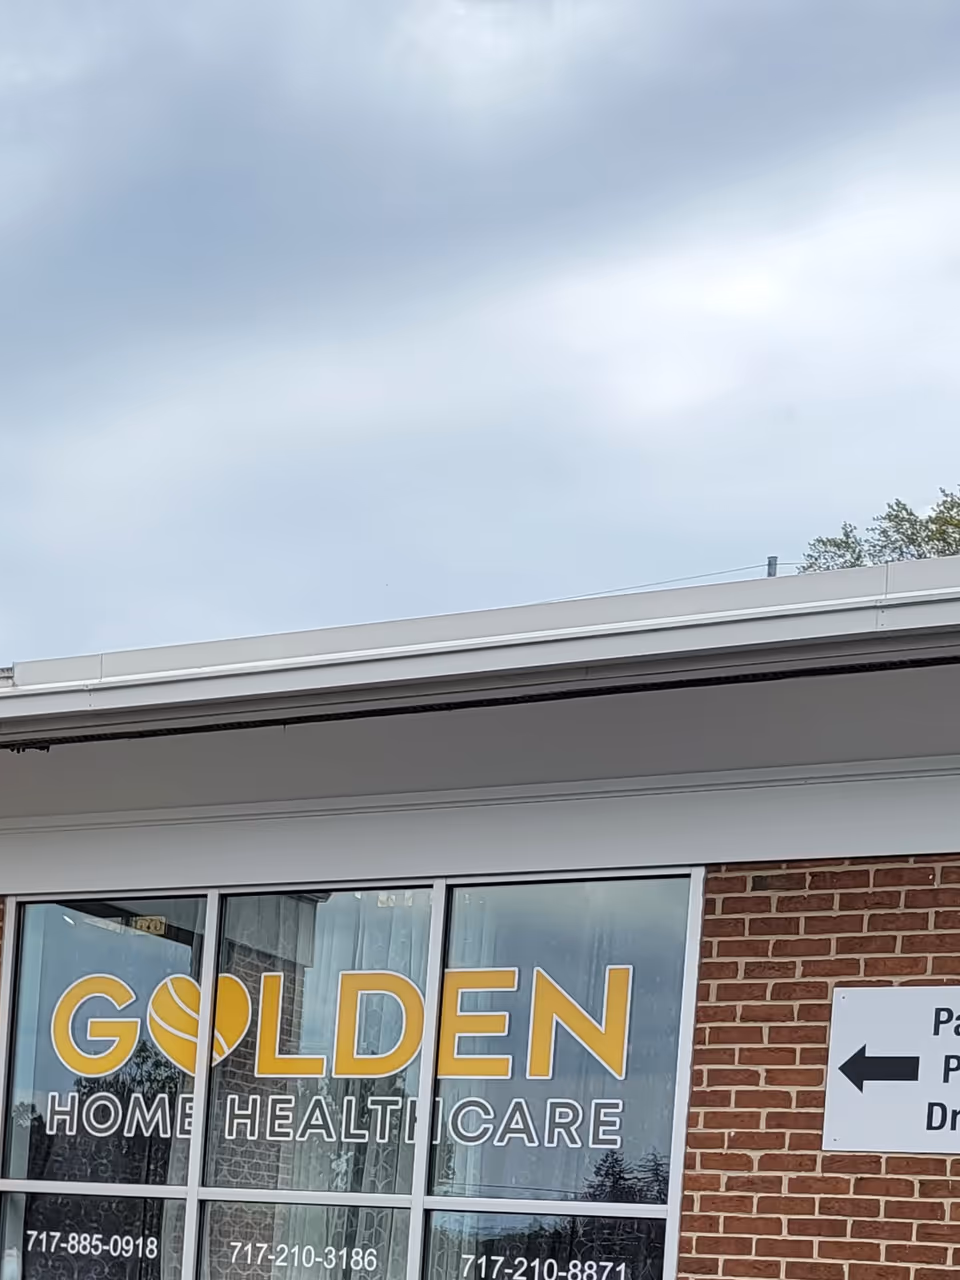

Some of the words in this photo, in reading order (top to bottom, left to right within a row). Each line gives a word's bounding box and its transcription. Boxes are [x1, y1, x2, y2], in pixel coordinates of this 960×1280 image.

[51, 964, 634, 1081] GOLDEN
[45, 1091, 194, 1139] HOME
[225, 1094, 623, 1149] HEALTHCARE
[26, 1230, 159, 1260] 717-885-0918
[229, 1241, 378, 1272] 717-210-3186
